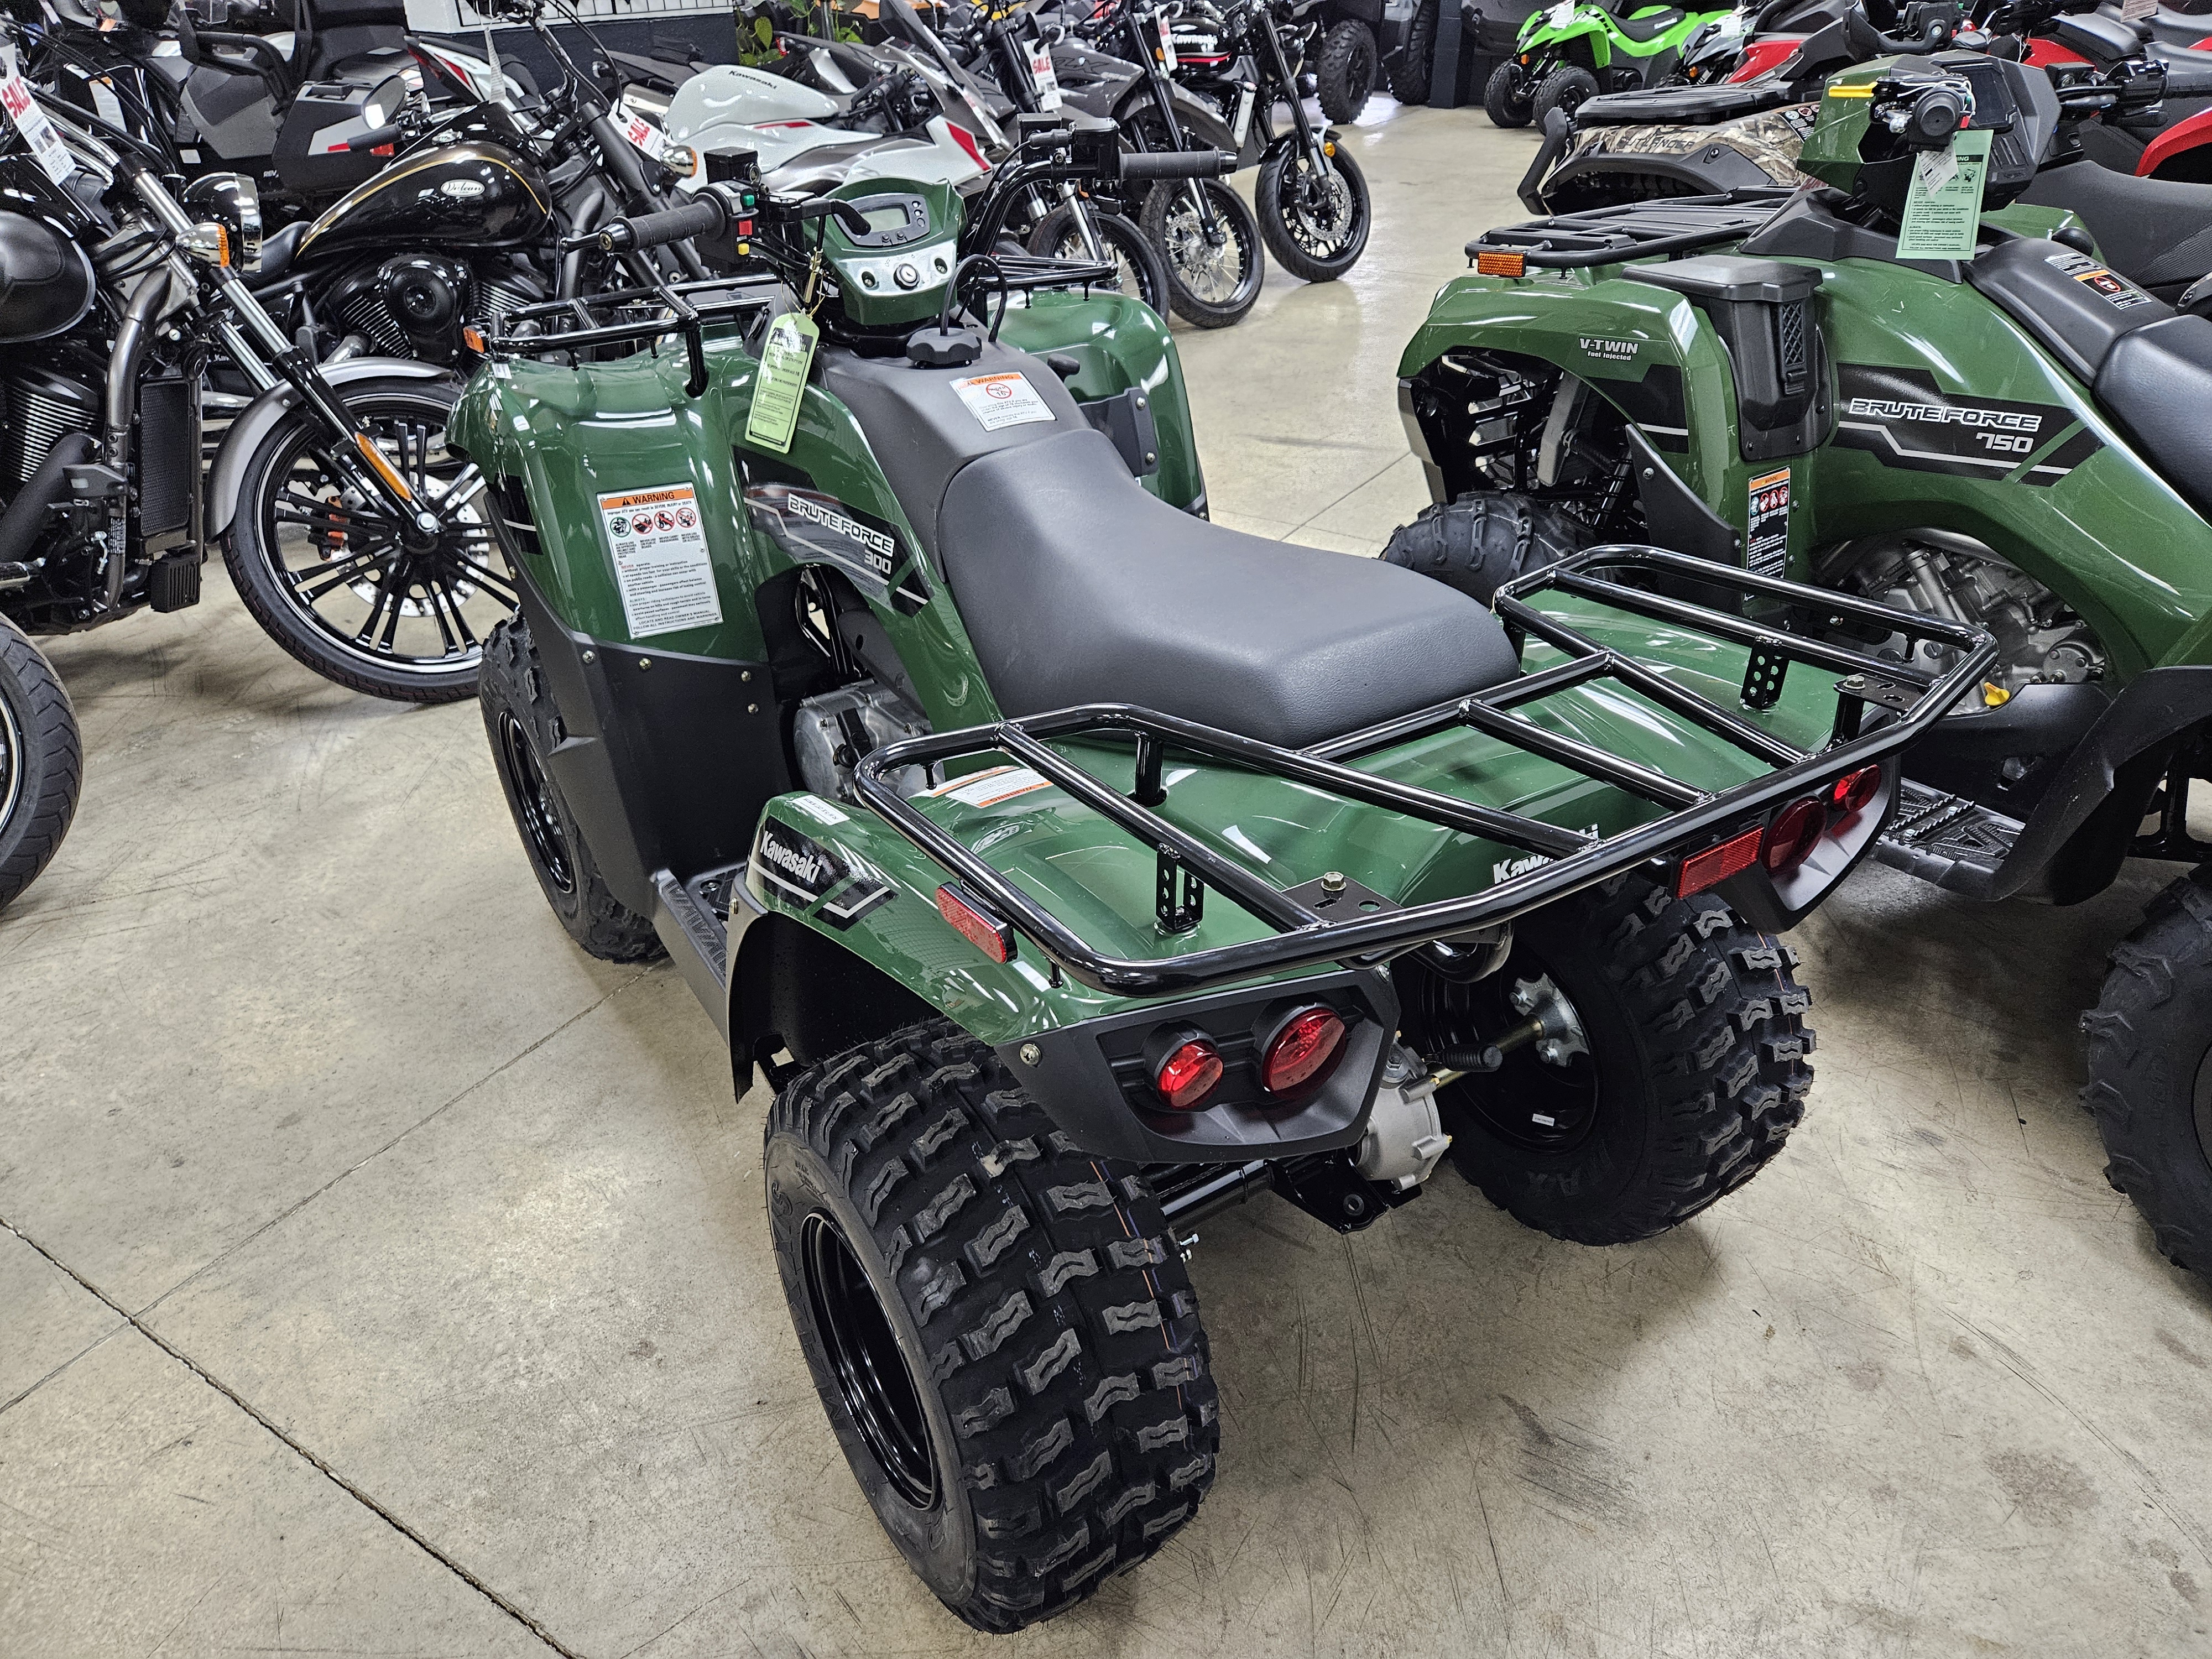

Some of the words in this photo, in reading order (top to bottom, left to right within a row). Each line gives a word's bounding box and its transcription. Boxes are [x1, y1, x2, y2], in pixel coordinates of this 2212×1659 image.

[1033, 56, 1051, 74] SALE
[729, 70, 777, 89] Kawasaki
[2, 75, 31, 119] SALE
[628, 117, 650, 147] SALE
[442, 181, 481, 192] Vulcan
[1580, 338, 1638, 354] V-TWIN
[1603, 352, 1631, 361] Injected
[1975, 432, 2034, 453] 750
[633, 492, 675, 504] WARNING
[864, 549, 891, 574] 300
[760, 831, 823, 884] Kawasaki
